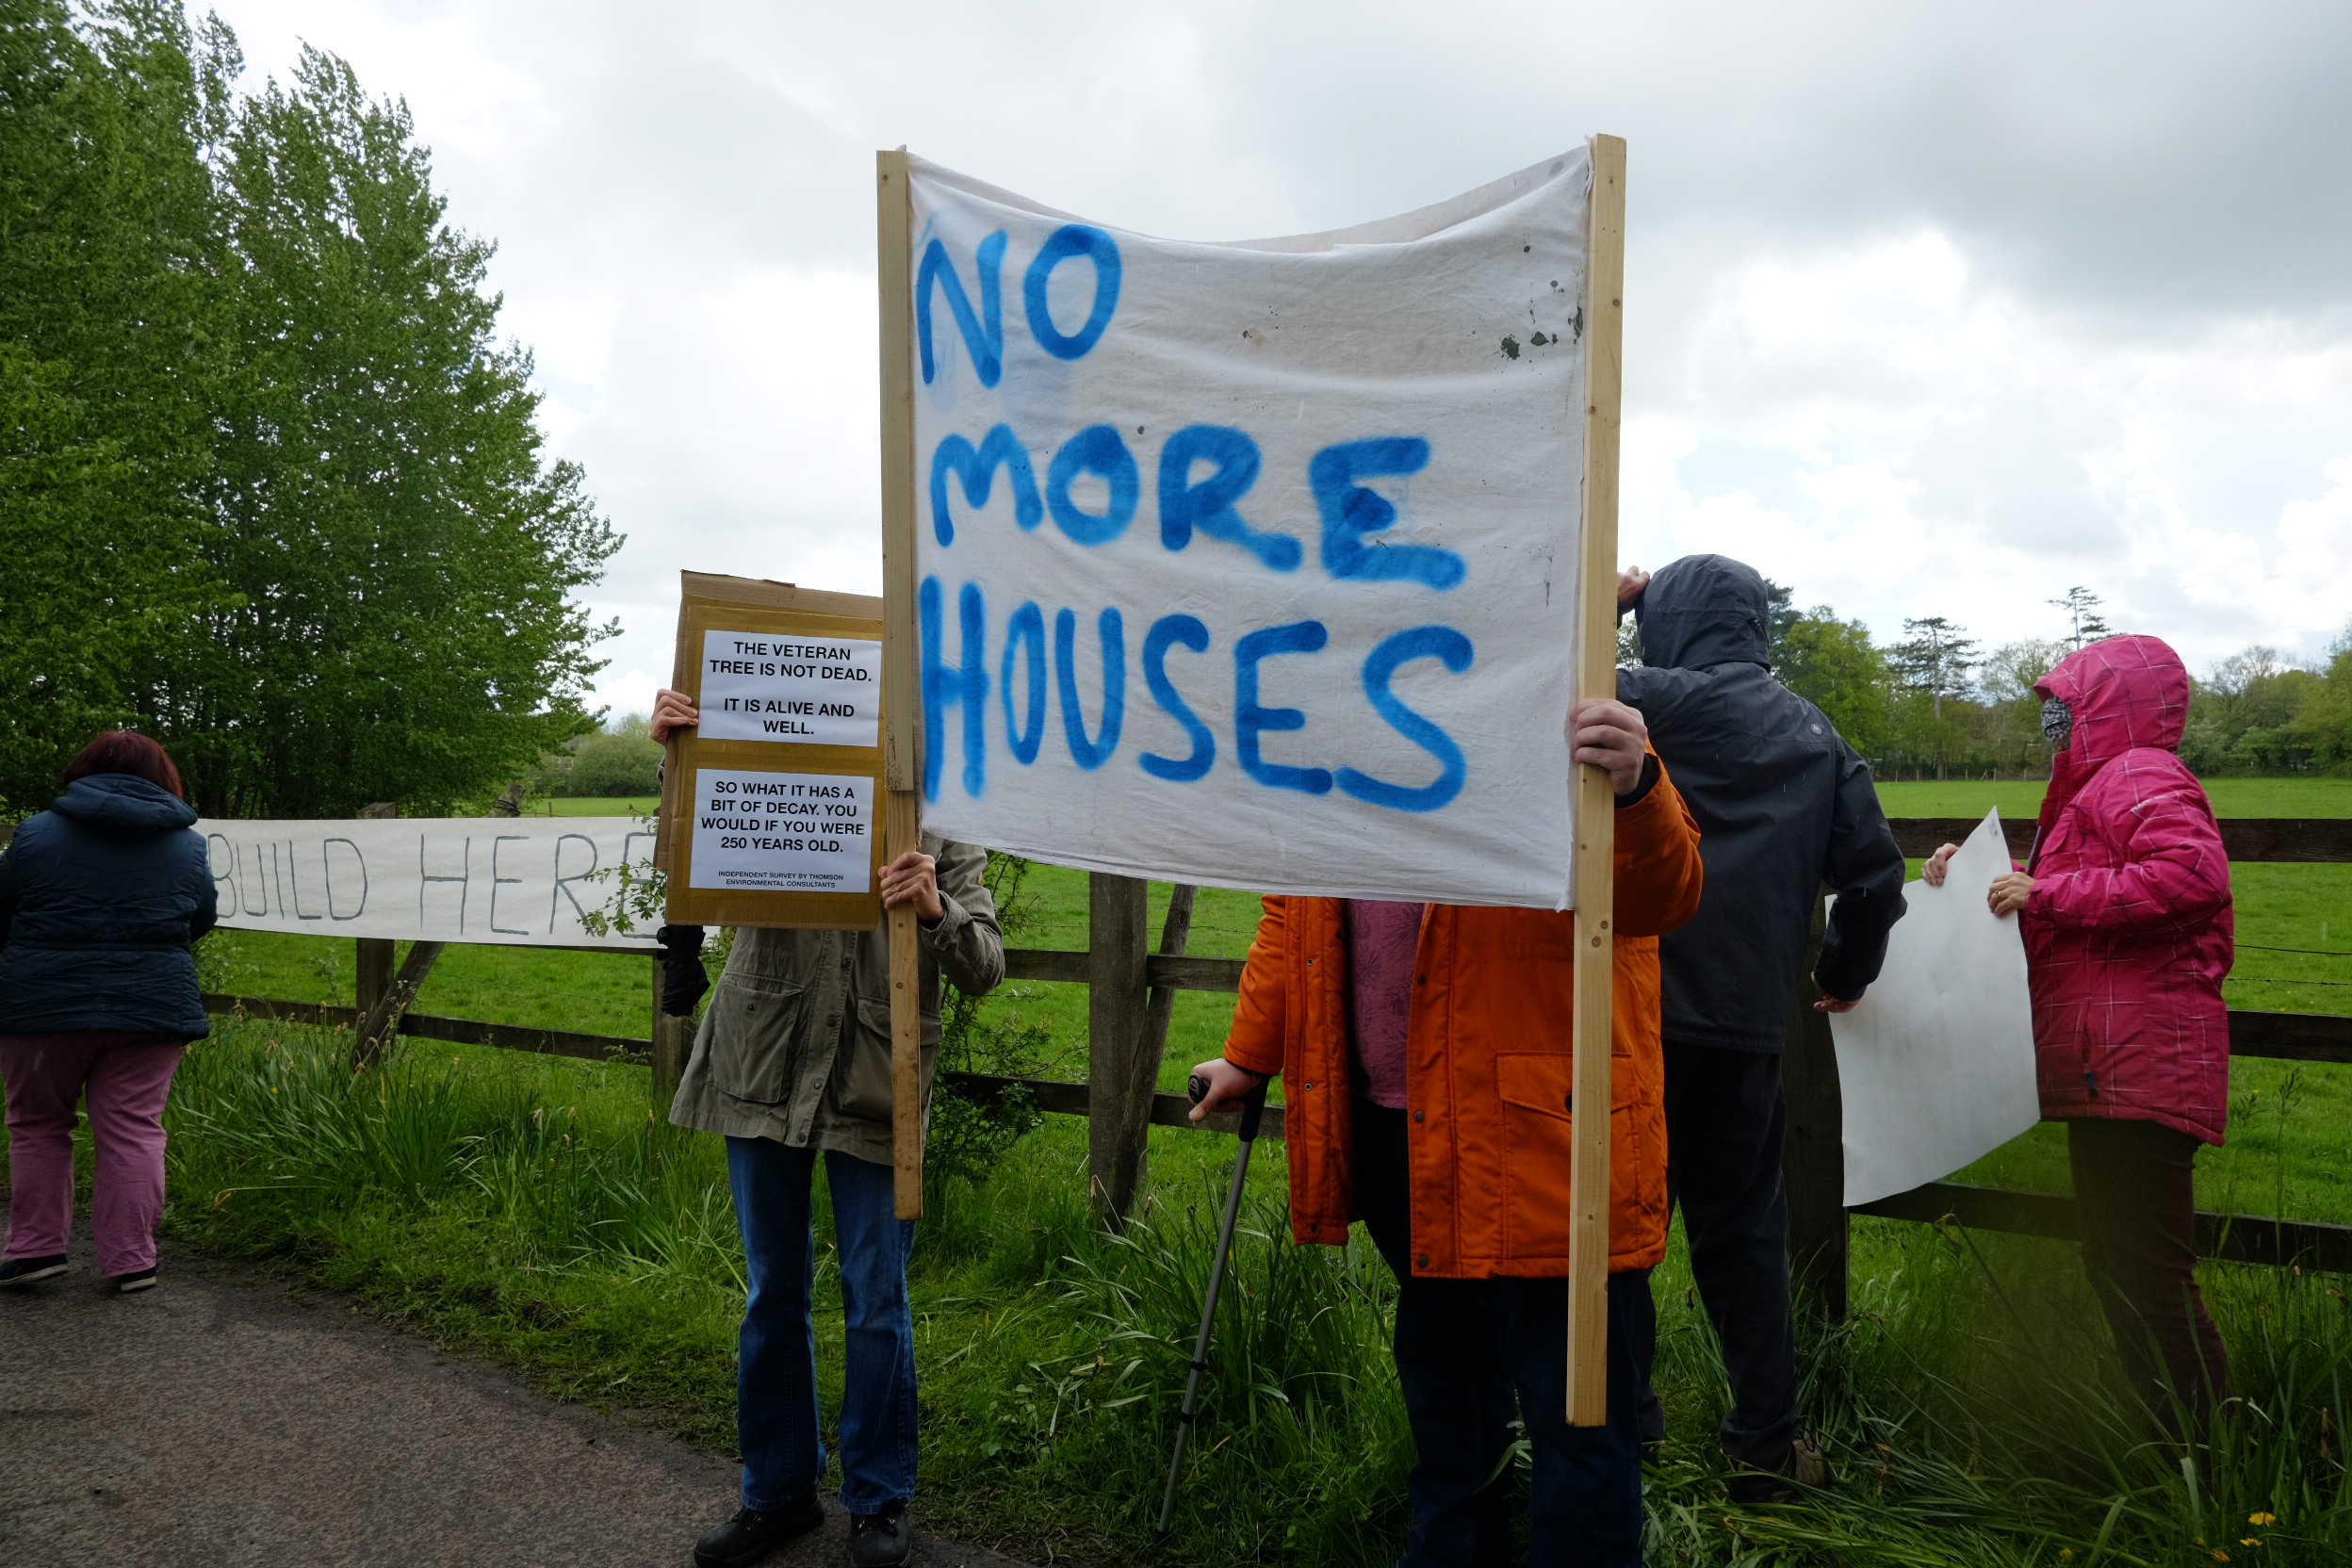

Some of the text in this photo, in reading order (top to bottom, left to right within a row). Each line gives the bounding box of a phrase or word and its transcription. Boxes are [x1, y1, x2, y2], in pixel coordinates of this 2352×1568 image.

[915, 222, 1122, 388] NO
[929, 422, 1467, 592] MORE
[733, 641, 851, 661] THE VETERAN
[710, 660, 872, 681] TREE IS NOT DEAD.
[919, 573, 1475, 814] HOUSES
[724, 698, 855, 717] IT IS ALIVE AND
[763, 720, 814, 734] WELL.
[715, 781, 855, 799] SO WHAT IT HAS A
[711, 799, 858, 817] BIT OF DECAY. YOU
[701, 817, 864, 835] WOULD IF YOU WERE
[721, 836, 843, 853] 250 YEARS OLD.
[207, 833, 658, 939] BUILD HERE
